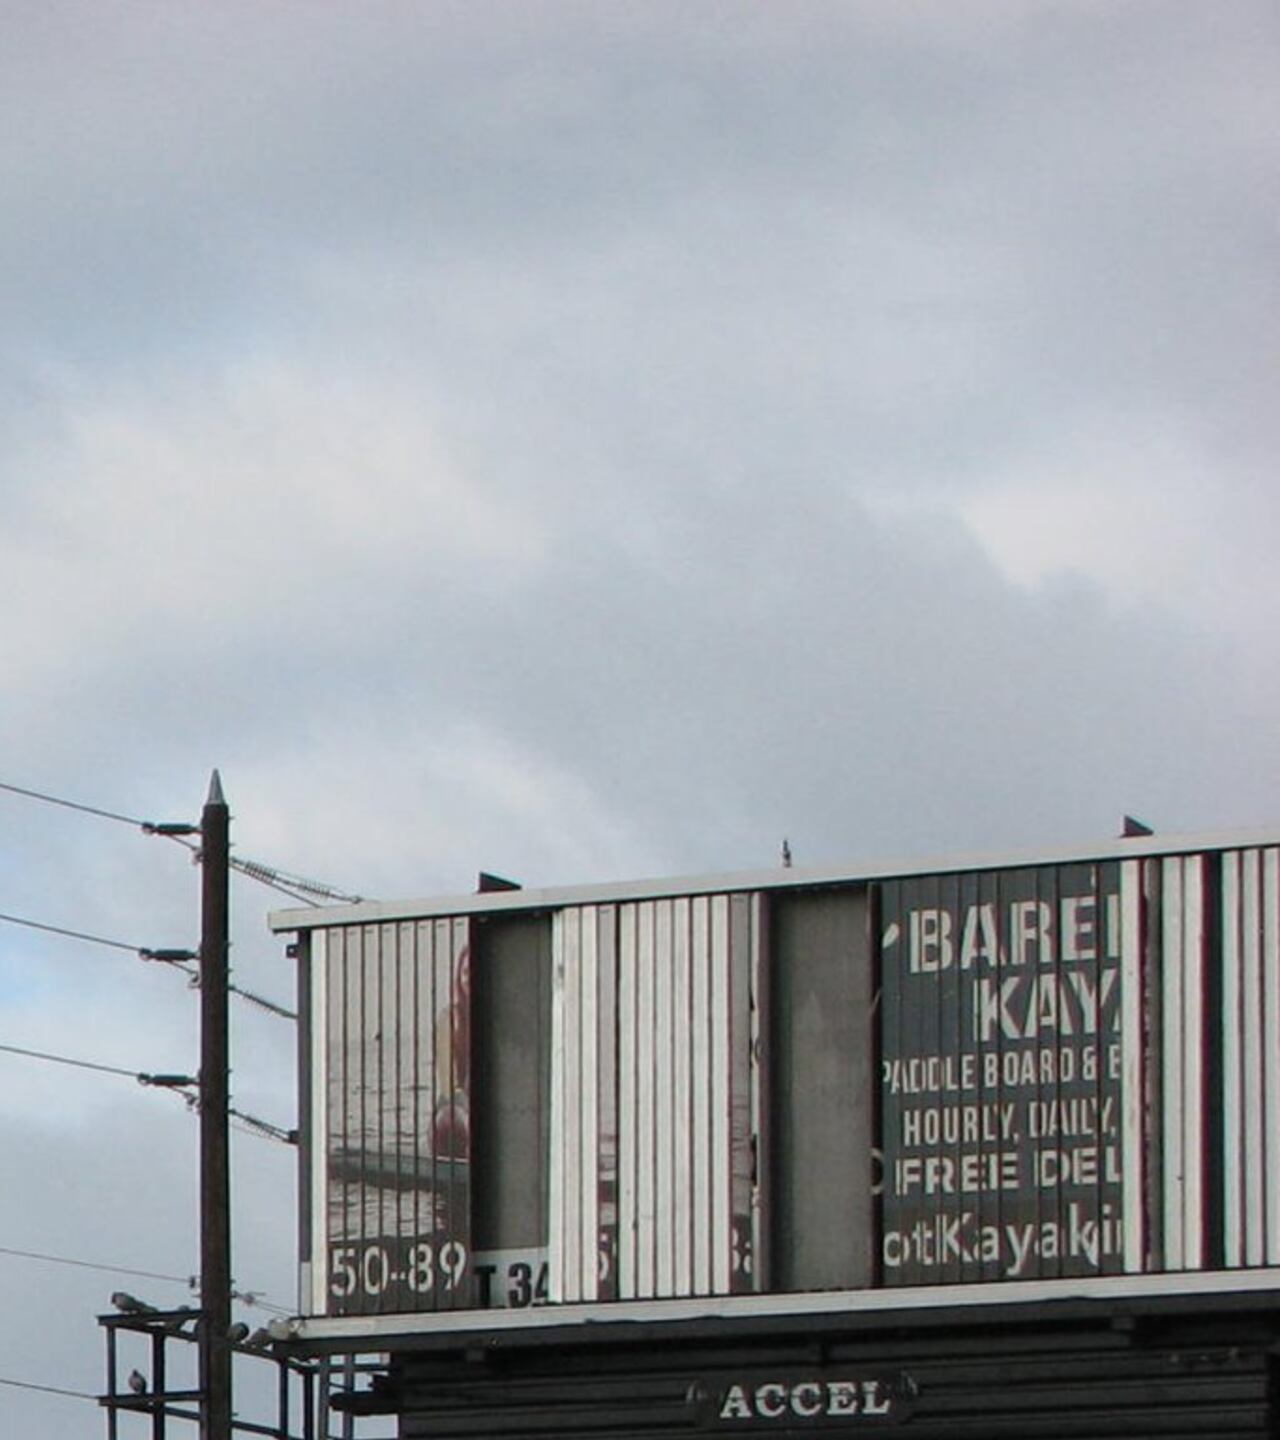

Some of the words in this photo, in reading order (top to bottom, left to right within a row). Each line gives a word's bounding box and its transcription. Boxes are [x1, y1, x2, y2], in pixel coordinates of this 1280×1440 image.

[972, 968, 1121, 1042] KAY
[984, 1047, 1074, 1089] BOARD
[1082, 1046, 1097, 1080] &
[903, 1103, 1019, 1147] HOURLY,
[1028, 1097, 1117, 1140] DAILY,
[895, 1152, 1019, 1195] FREE
[1033, 1146, 1123, 1188] DEL
[883, 1203, 1122, 1276] otKayaki
[719, 1380, 891, 1419] ACCEL
